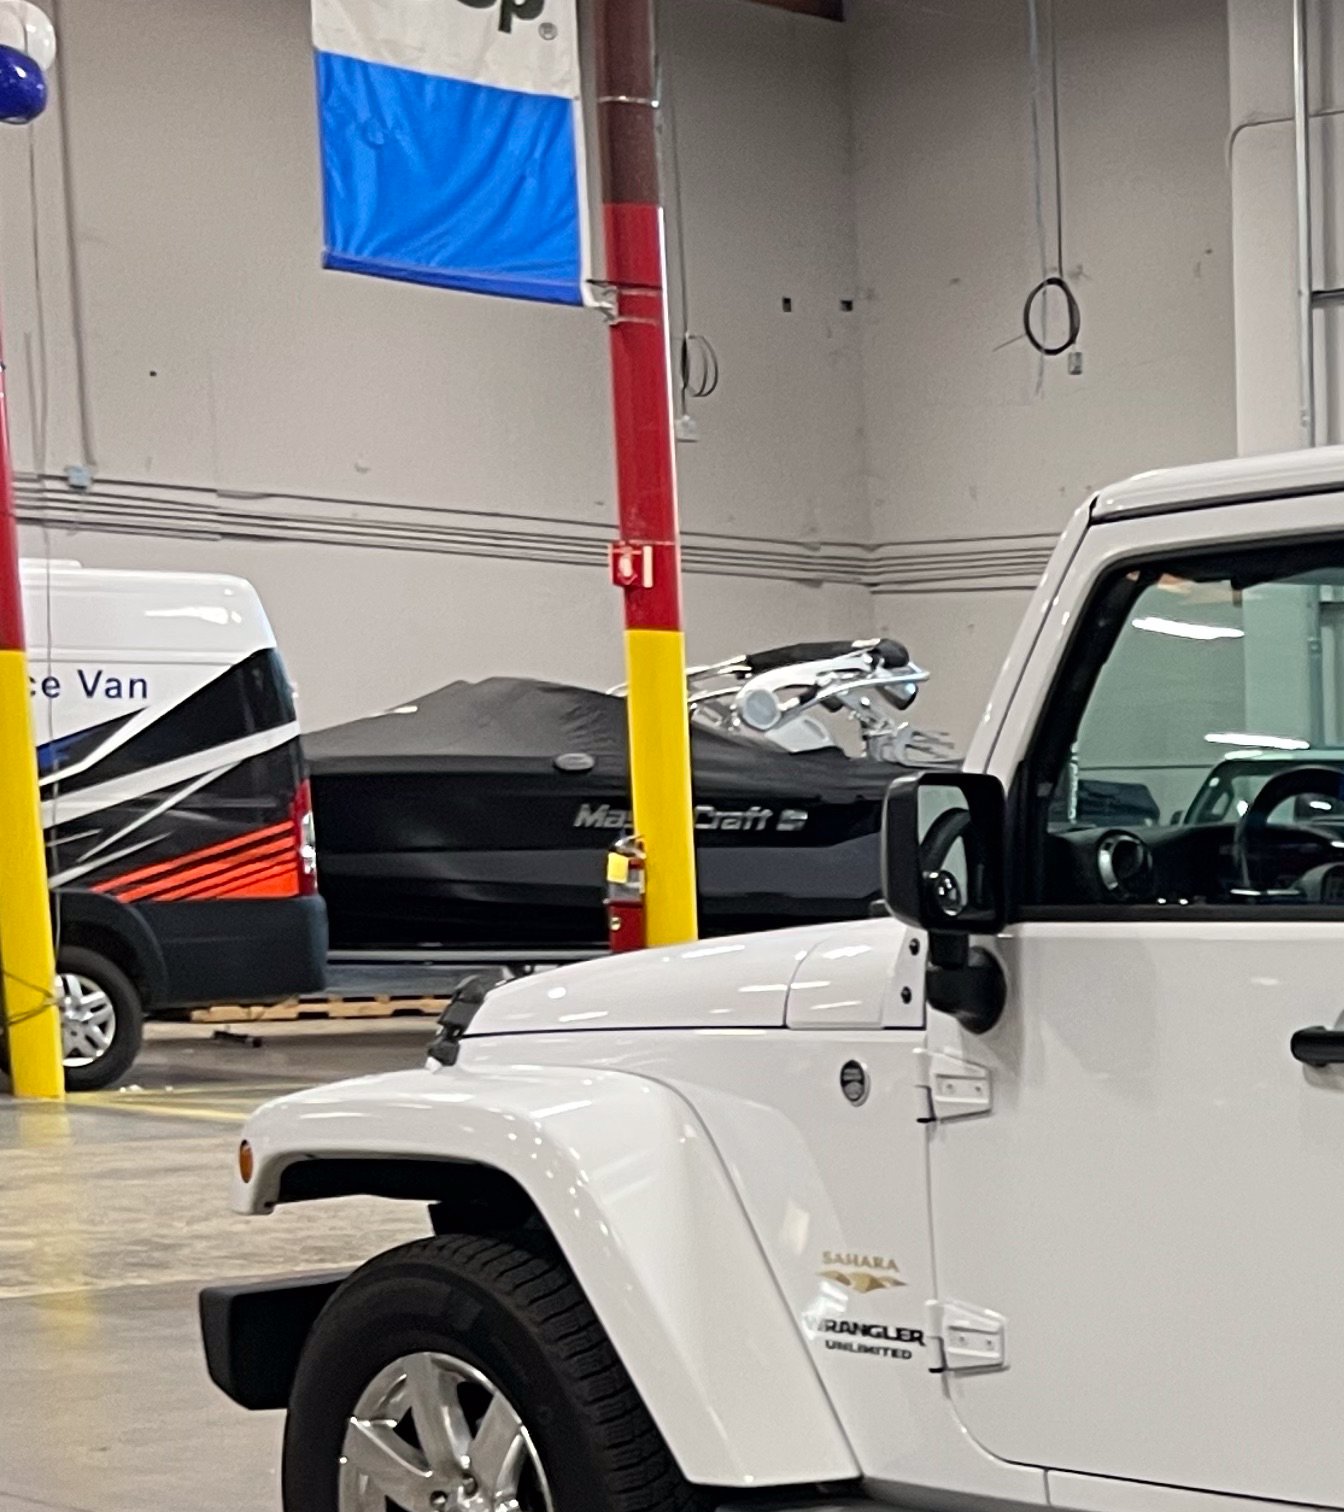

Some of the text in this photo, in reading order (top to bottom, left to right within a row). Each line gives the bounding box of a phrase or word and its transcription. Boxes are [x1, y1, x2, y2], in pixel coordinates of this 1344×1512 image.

[77, 669, 147, 699] Van
[822, 1251, 899, 1271] SAHARA
[805, 1318, 925, 1346] RANGLER
[825, 1340, 912, 1360] UNLIMITED
